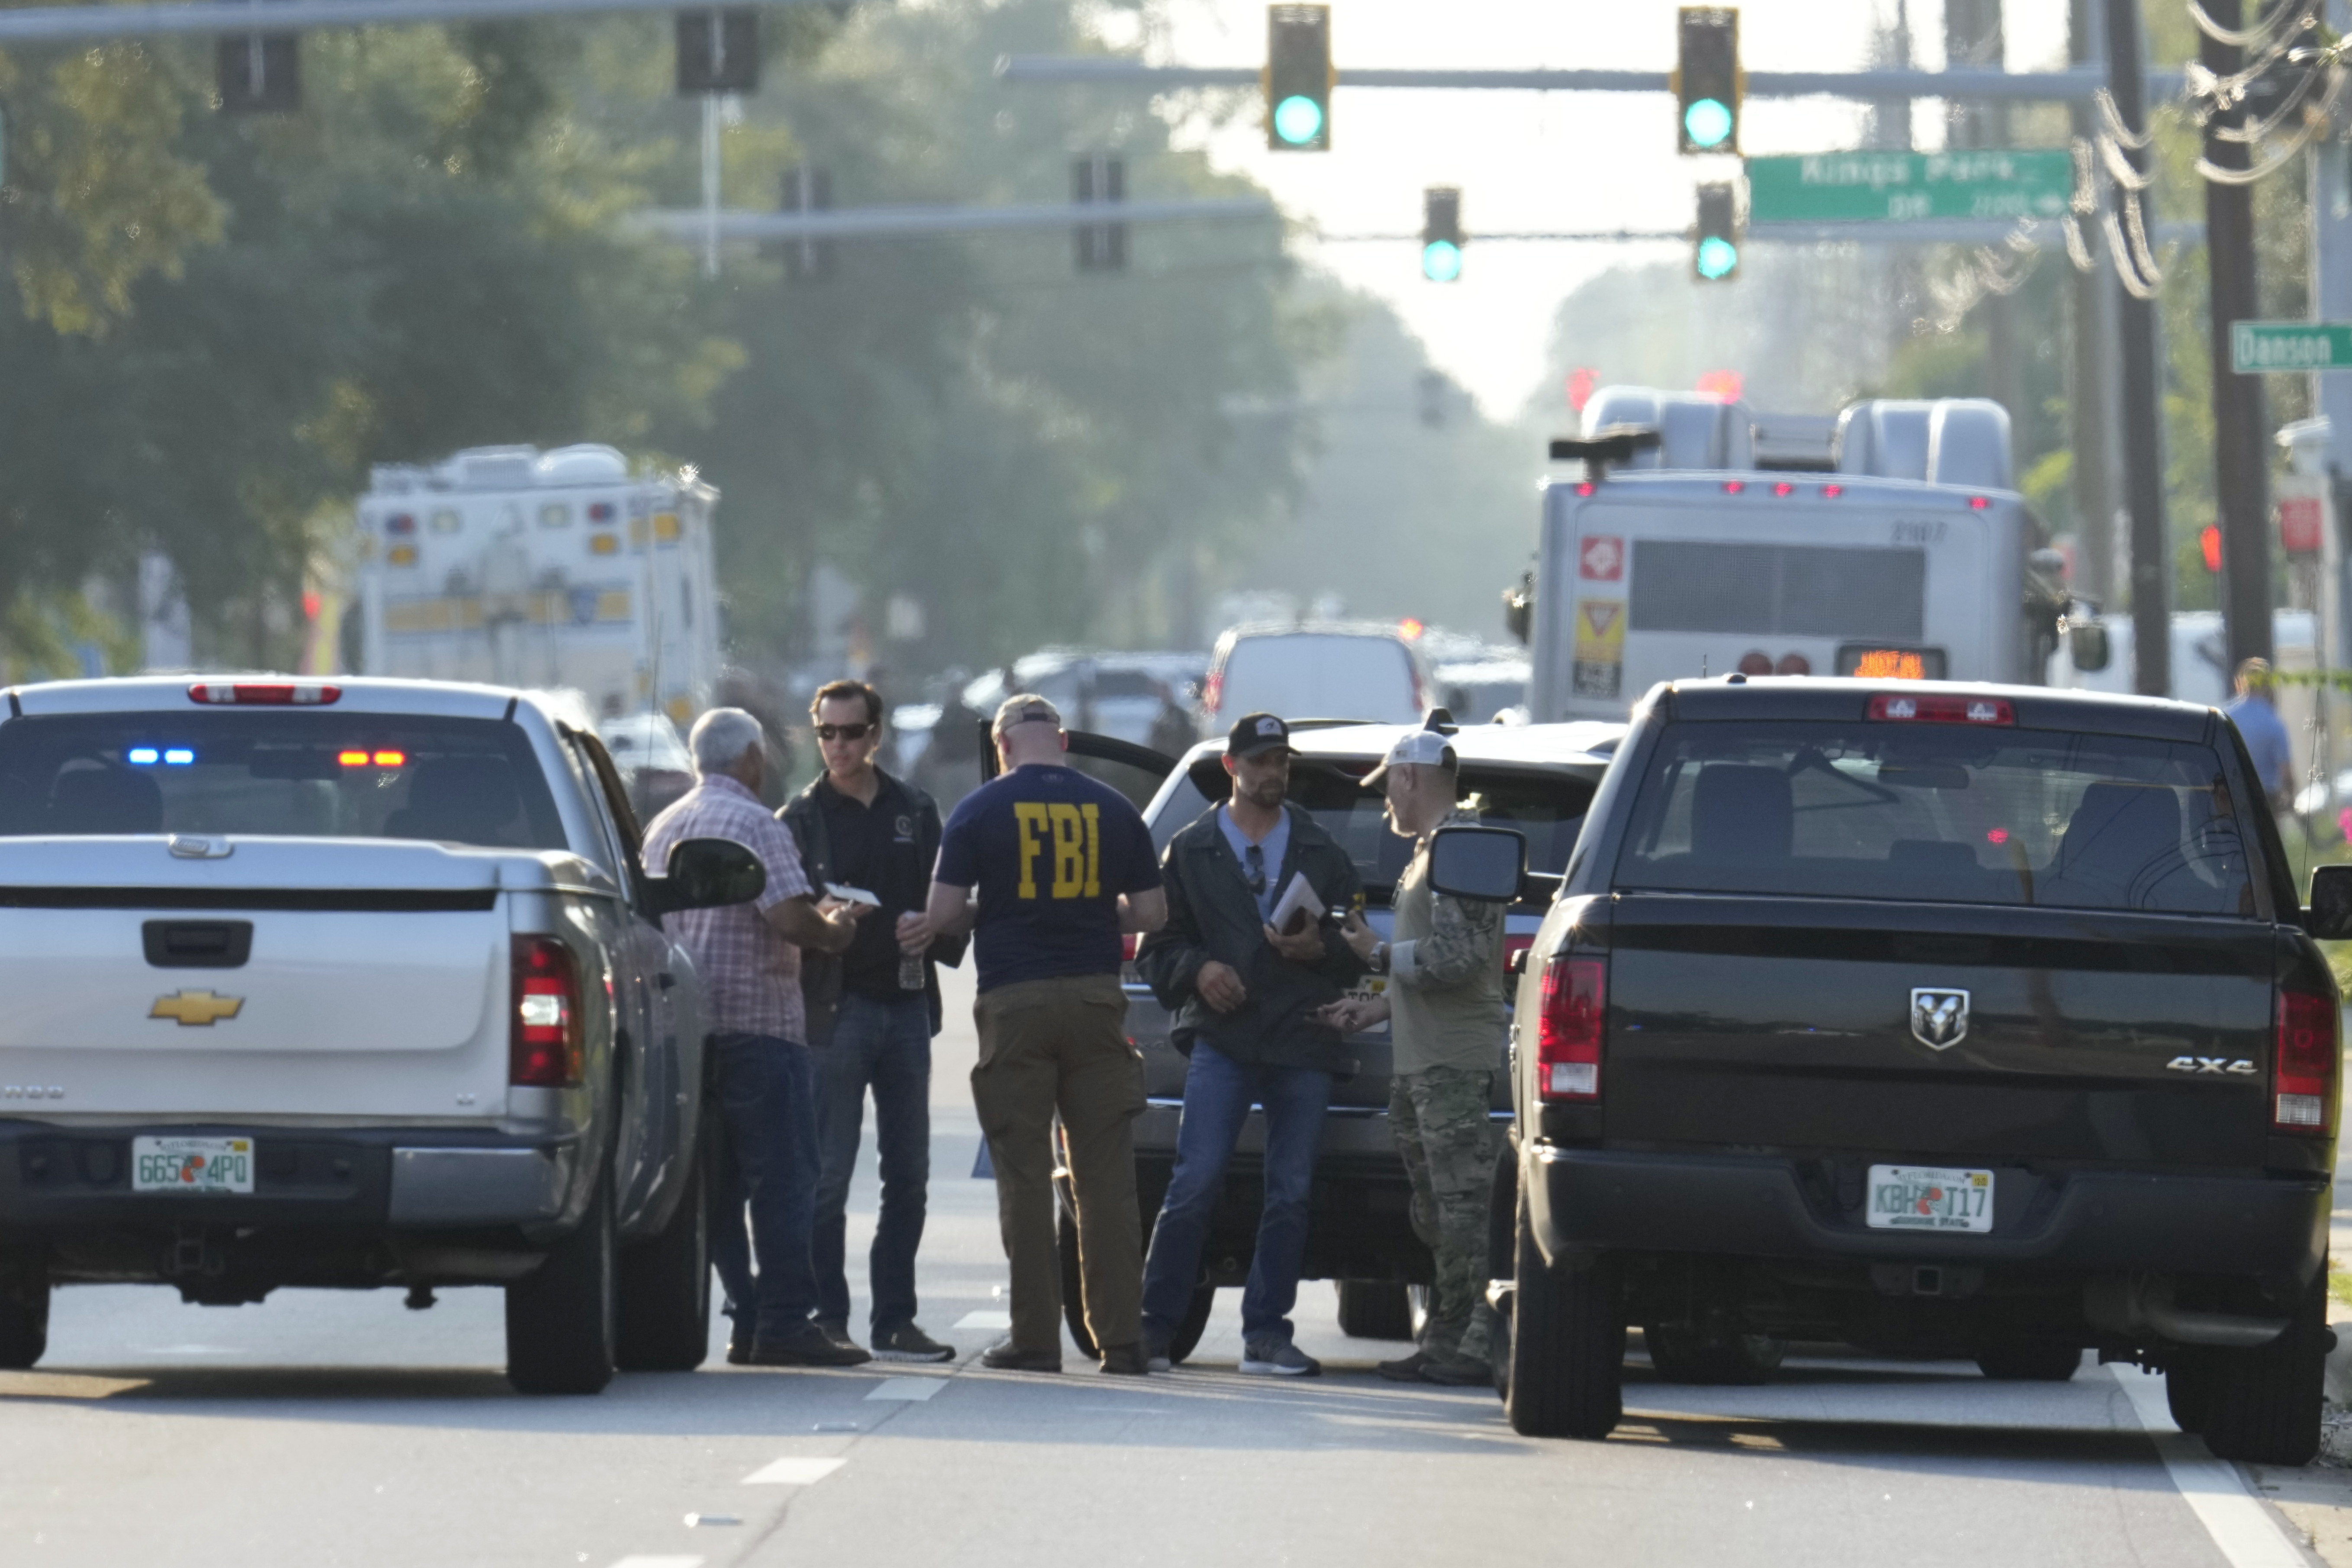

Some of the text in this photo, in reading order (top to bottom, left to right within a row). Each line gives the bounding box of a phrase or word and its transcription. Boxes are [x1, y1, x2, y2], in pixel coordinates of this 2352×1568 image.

[1013, 802, 1100, 899] FBI
[139, 1155, 179, 1183] 665
[1875, 1184, 1985, 1217] KBH T17
